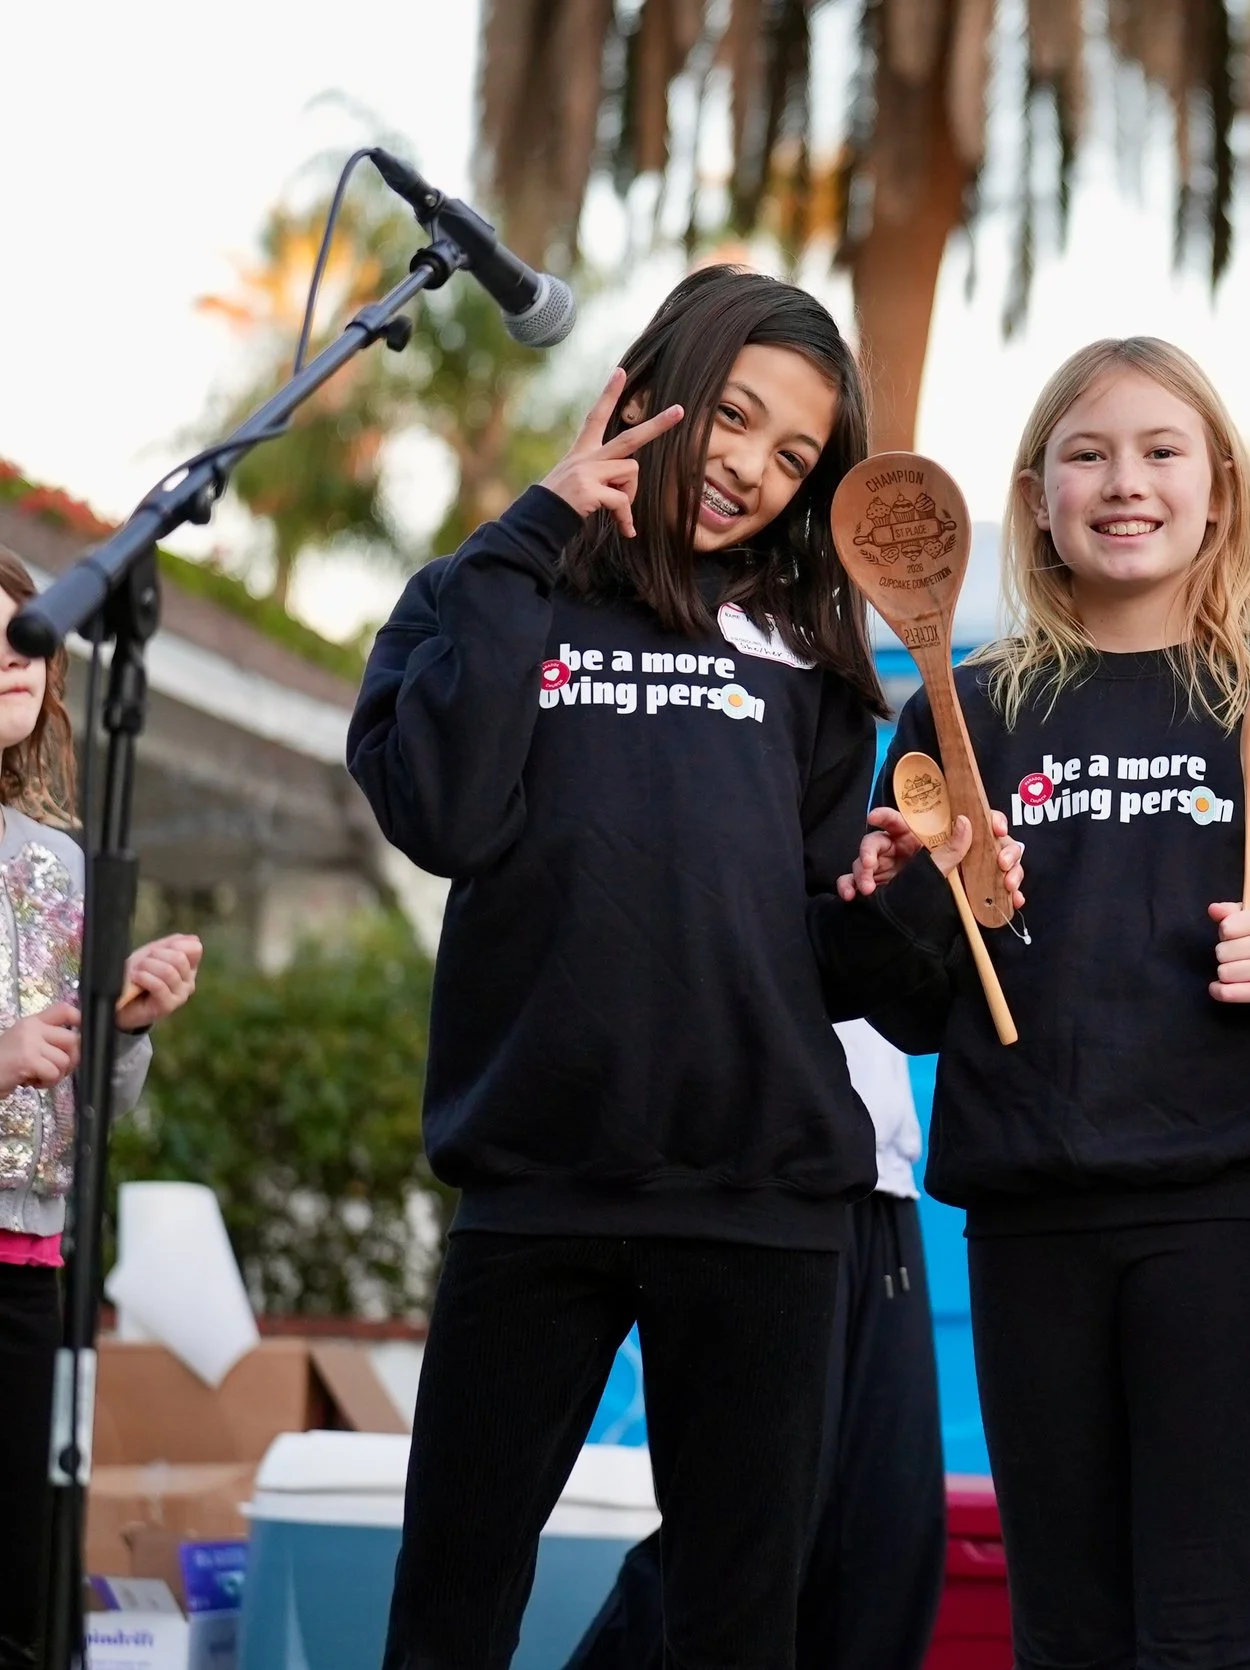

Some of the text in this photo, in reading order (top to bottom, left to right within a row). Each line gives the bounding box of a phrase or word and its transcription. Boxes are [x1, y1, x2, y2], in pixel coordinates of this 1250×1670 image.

[865, 469, 924, 493] CHAMPION
[905, 524, 927, 536] PLACE
[878, 566, 952, 590] CUPCAKE COMPETITION
[906, 562, 924, 574] 2026
[559, 643, 735, 679] be a more
[538, 676, 637, 715] oving
[1043, 754, 1207, 786] be a more
[1011, 787, 1112, 827] loving
